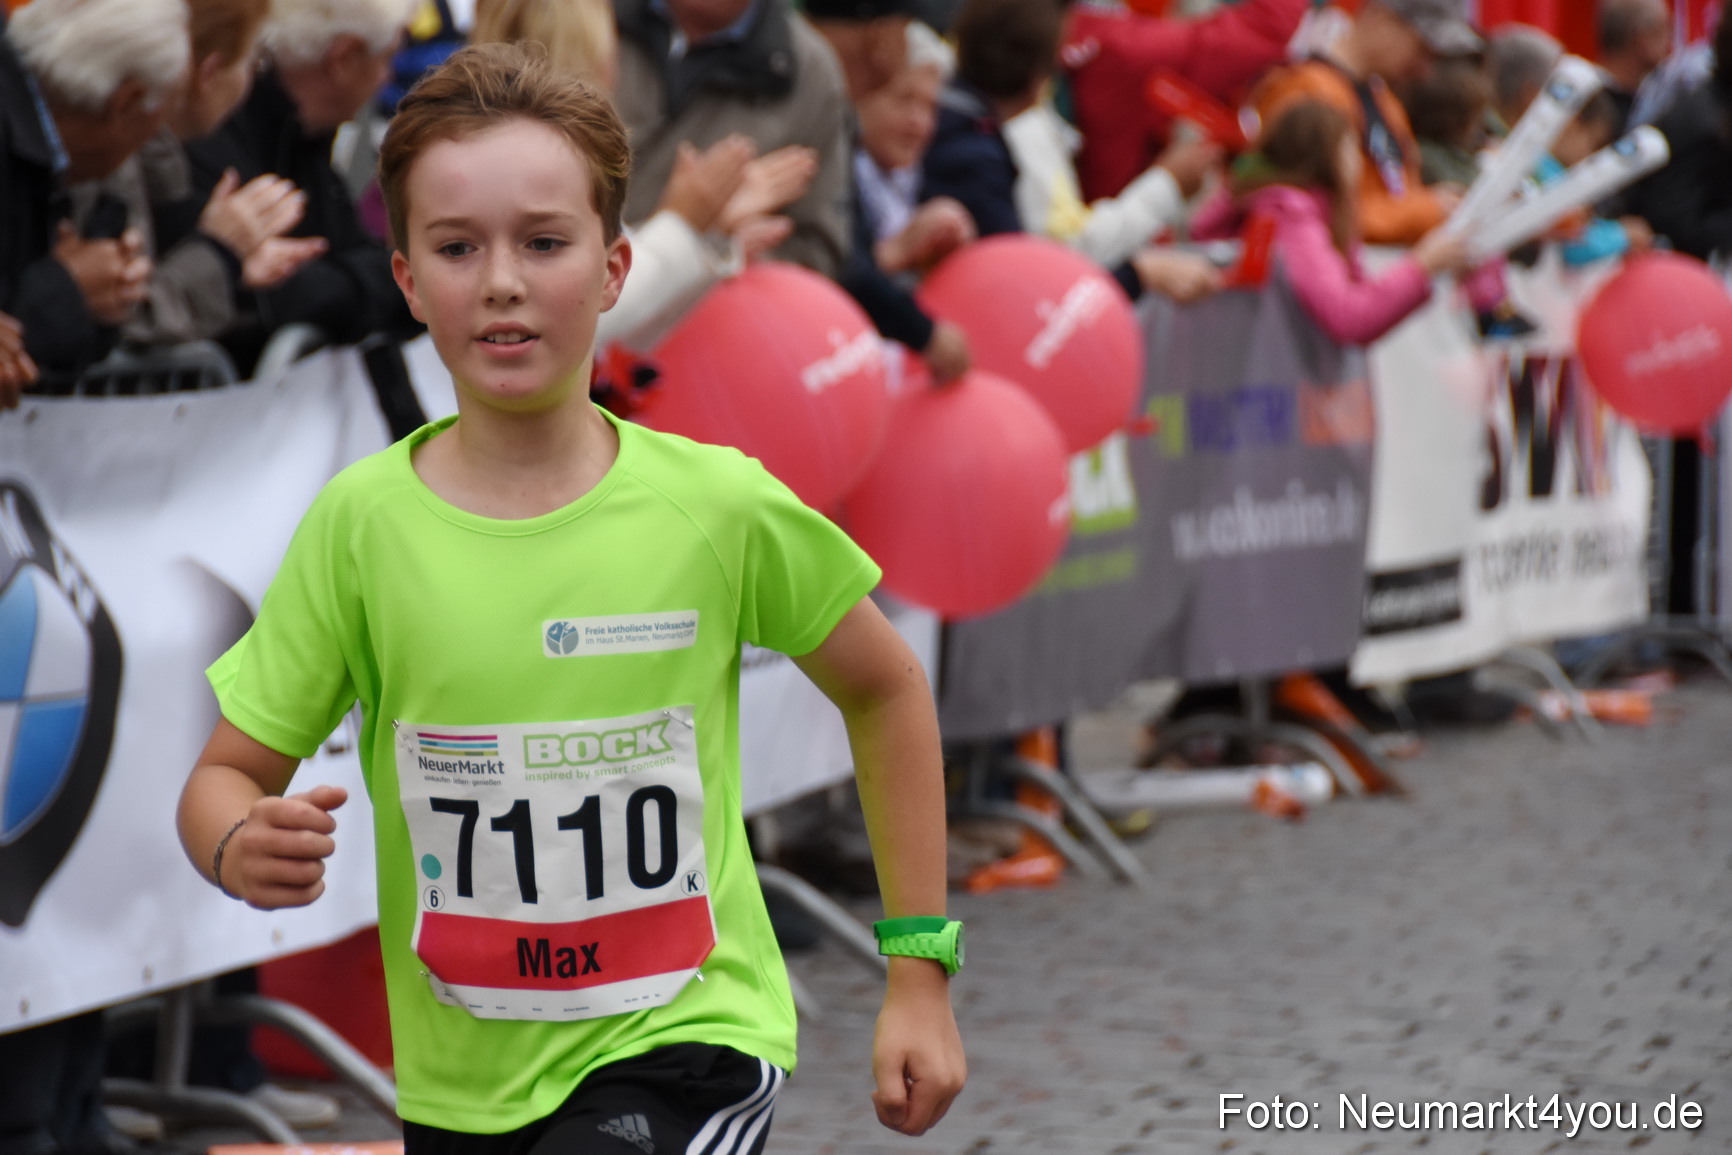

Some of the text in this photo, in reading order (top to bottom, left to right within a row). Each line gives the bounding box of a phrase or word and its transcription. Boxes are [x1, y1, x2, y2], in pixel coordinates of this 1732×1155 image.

[585, 619, 696, 635] Freie katholische Volksschule
[585, 637, 595, 645] im
[597, 636, 614, 644] Haus
[523, 719, 673, 769] BOCK
[418, 755, 505, 775] NeuerMarkt
[525, 755, 677, 783] inspired by smart concepts
[424, 774, 451, 784] einkaufen
[471, 779, 502, 788] genießen
[429, 785, 679, 905] 7110
[687, 873, 699, 893] K
[429, 889, 440, 908] 6
[516, 937, 603, 979] Max
[597, 1123, 655, 1155] adidas
